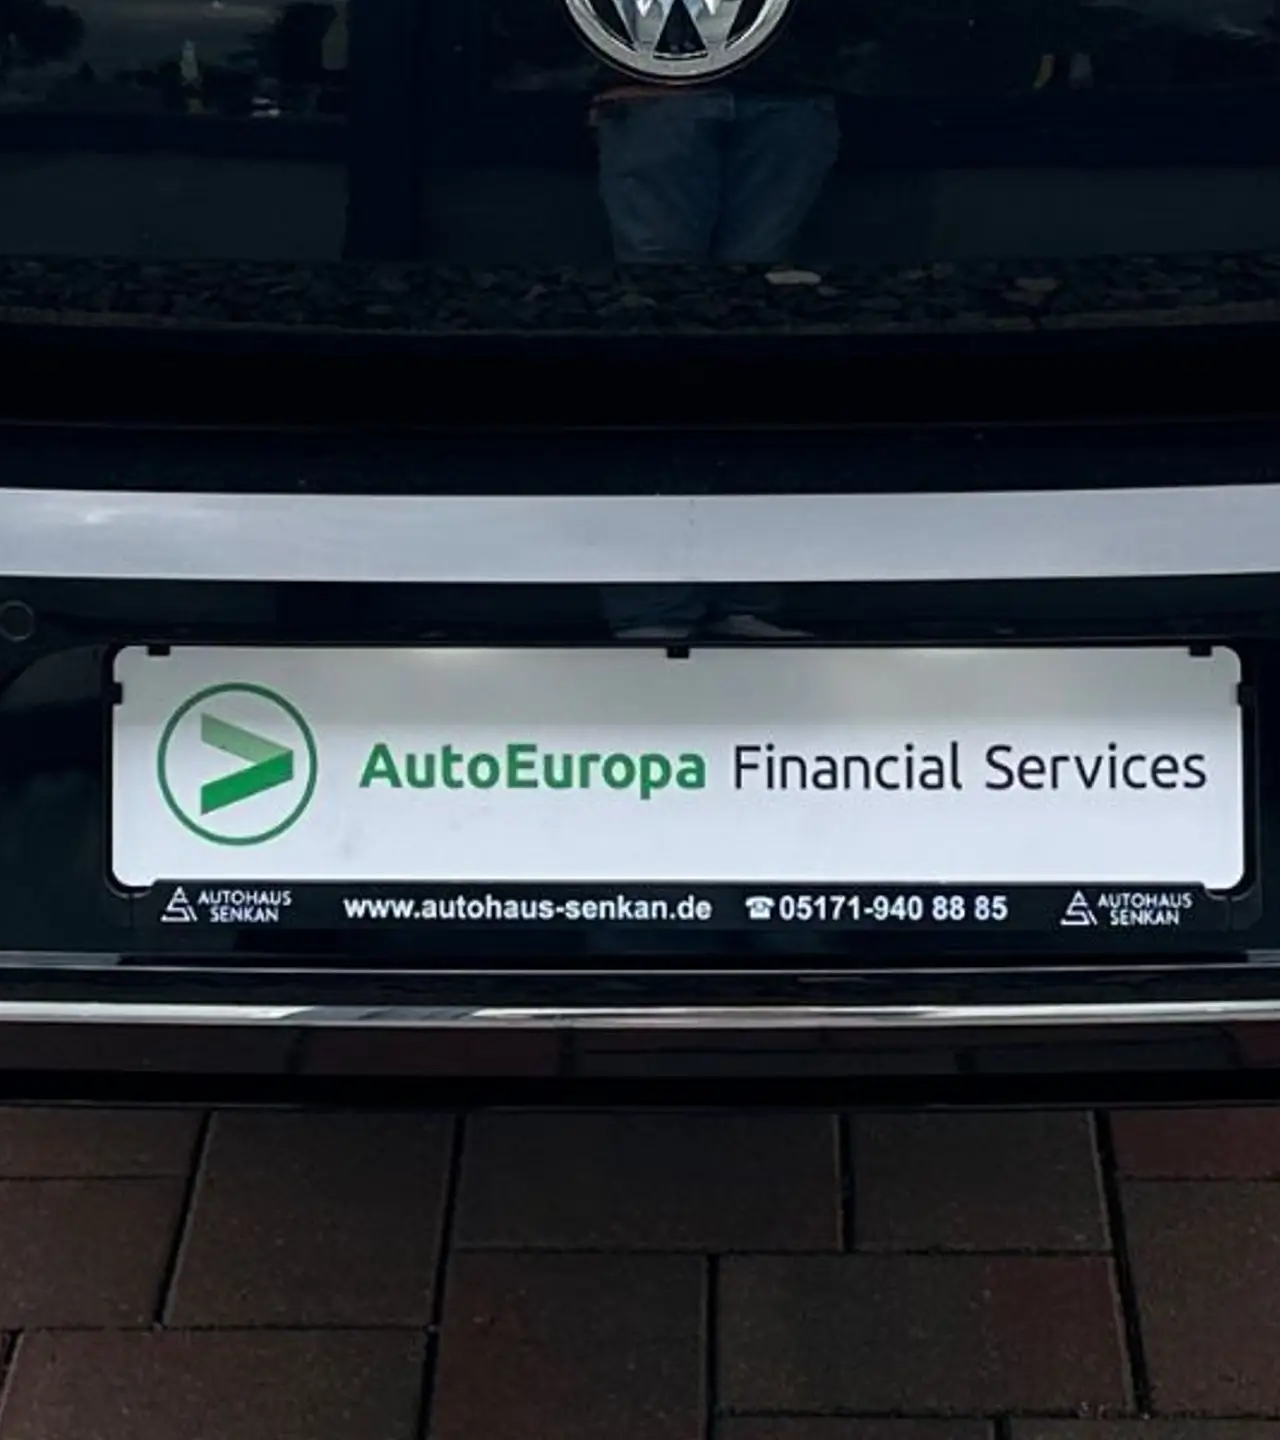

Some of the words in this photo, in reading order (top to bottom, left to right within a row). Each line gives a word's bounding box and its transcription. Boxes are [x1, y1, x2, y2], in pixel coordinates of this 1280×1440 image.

[358, 742, 707, 800] AutoEuropa
[733, 741, 963, 791] Financial
[984, 743, 1208, 791] Services
[196, 889, 293, 906] AUTOHAUS
[1097, 891, 1194, 909] AUTOHAUS
[209, 905, 280, 923] SENKAN
[342, 893, 713, 922] www.autohaus-senkan.de
[931, 896, 966, 922] 88
[973, 896, 1009, 922] 85
[1109, 908, 1180, 926] SENKAN
